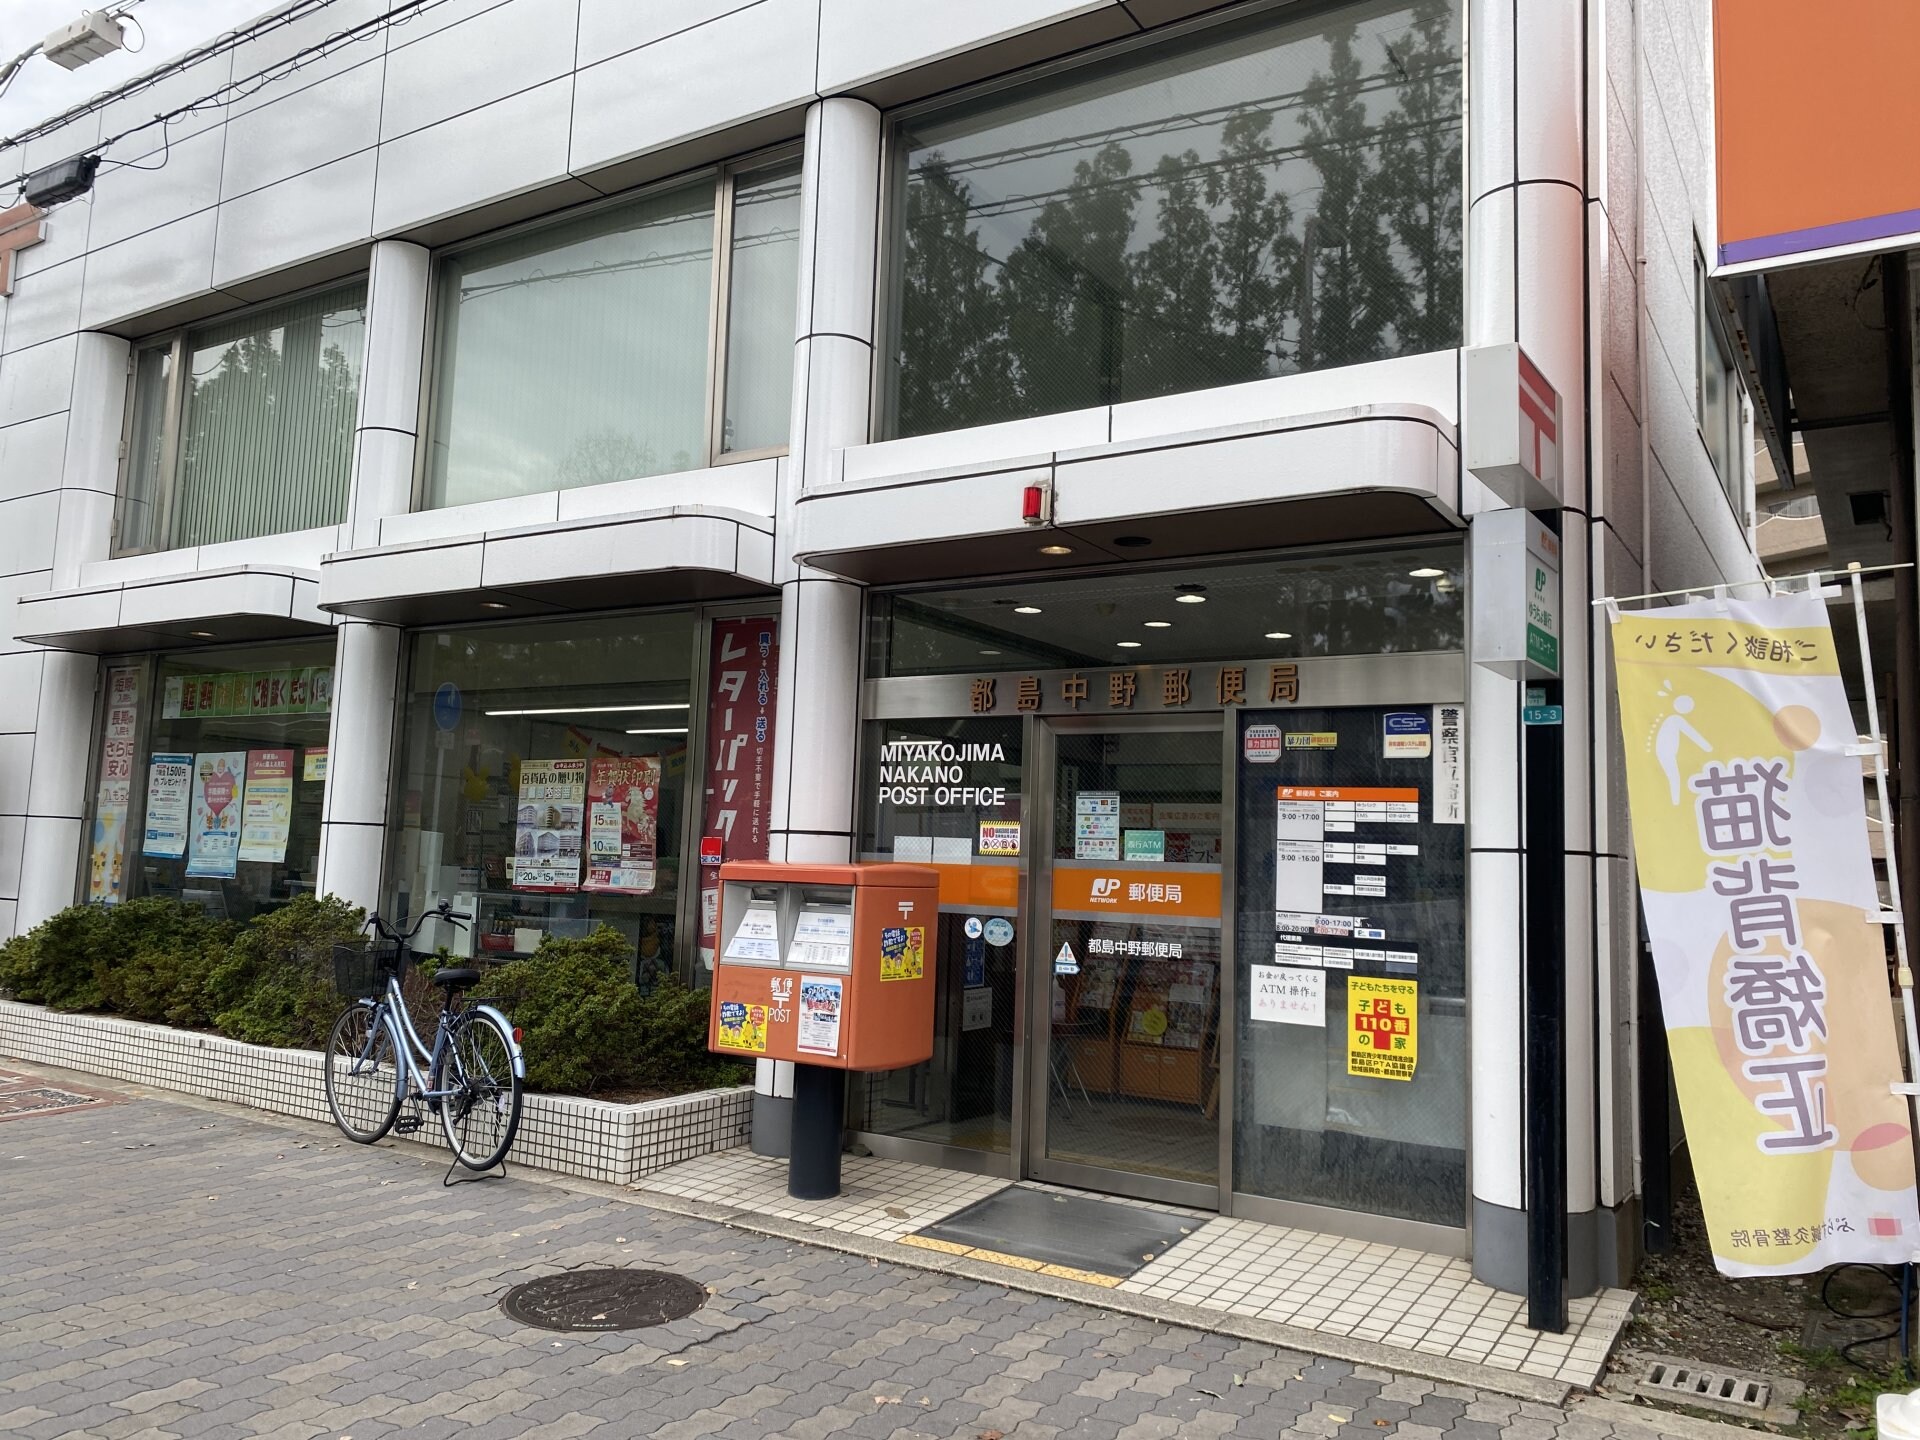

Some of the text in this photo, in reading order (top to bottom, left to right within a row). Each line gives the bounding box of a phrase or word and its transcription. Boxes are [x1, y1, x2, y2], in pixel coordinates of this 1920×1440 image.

[1528, 601, 1553, 631] ゆうちょ銀行
[756, 632, 771, 742] 買う 入れる 送る
[970, 663, 1300, 713] 都島中野郵便局
[112, 710, 134, 726] 長期の
[1389, 717, 1426, 728] CSP
[1528, 710, 1557, 720] 15-3
[714, 632, 749, 842] レターパック
[106, 741, 134, 758] さらに
[880, 743, 1005, 762] MIYAKOJIMA
[107, 759, 129, 777] 安心
[879, 765, 963, 784] NAKANO
[521, 771, 584, 784] 百貨店の贈り物
[595, 769, 656, 786] 年賀状印刷
[751, 747, 764, 844] 切手不要で手軽に送れる
[879, 786, 1006, 806] POST OFFICE
[1296, 789, 1316, 797] 郵便局
[1319, 790, 1340, 798] ご案内
[982, 827, 995, 839] NO
[1090, 878, 1182, 904] JP 郵便局
[1276, 924, 1309, 932] 8:00-20:00
[1315, 919, 1352, 928] 9:00-17:00
[1088, 938, 1183, 959] 都島中野郵便局
[1258, 970, 1319, 983] お金が戻ってくる
[770, 976, 793, 994] 郵便
[1259, 984, 1317, 998] ATM 操作は
[1351, 981, 1415, 995] 子どもたちを守る
[1257, 999, 1316, 1013] ありません!
[1358, 999, 1406, 1015] 子ども
[768, 1007, 792, 1023] POST
[1360, 1016, 1408, 1034] 110番
[1351, 1058, 1414, 1071] 都島区PTA協議会
